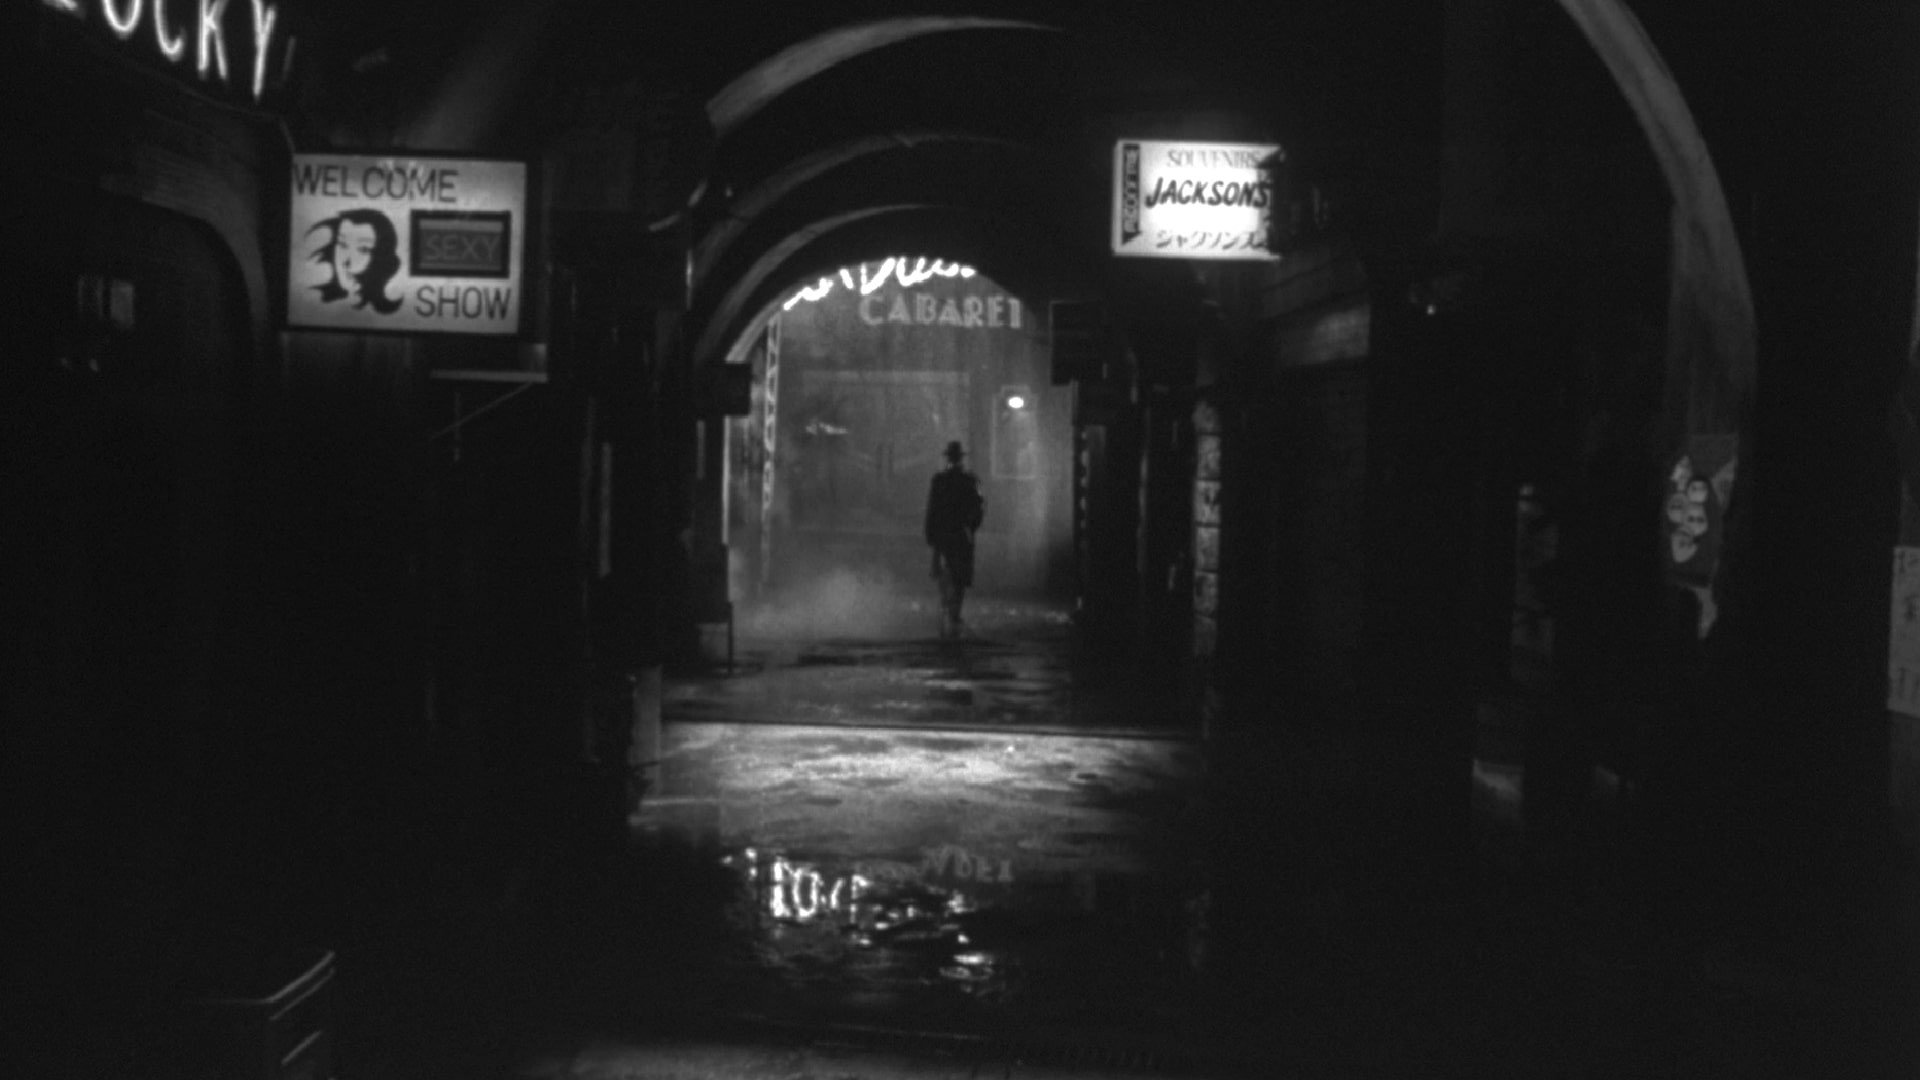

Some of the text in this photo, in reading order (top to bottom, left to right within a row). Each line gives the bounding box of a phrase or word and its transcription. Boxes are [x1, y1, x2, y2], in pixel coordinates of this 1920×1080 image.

[292, 162, 459, 203] WELCOME
[1144, 176, 1270, 209] JACKSONS
[424, 232, 500, 264] SEXY
[415, 284, 513, 320] SHOW
[858, 292, 1022, 330] CABARET
